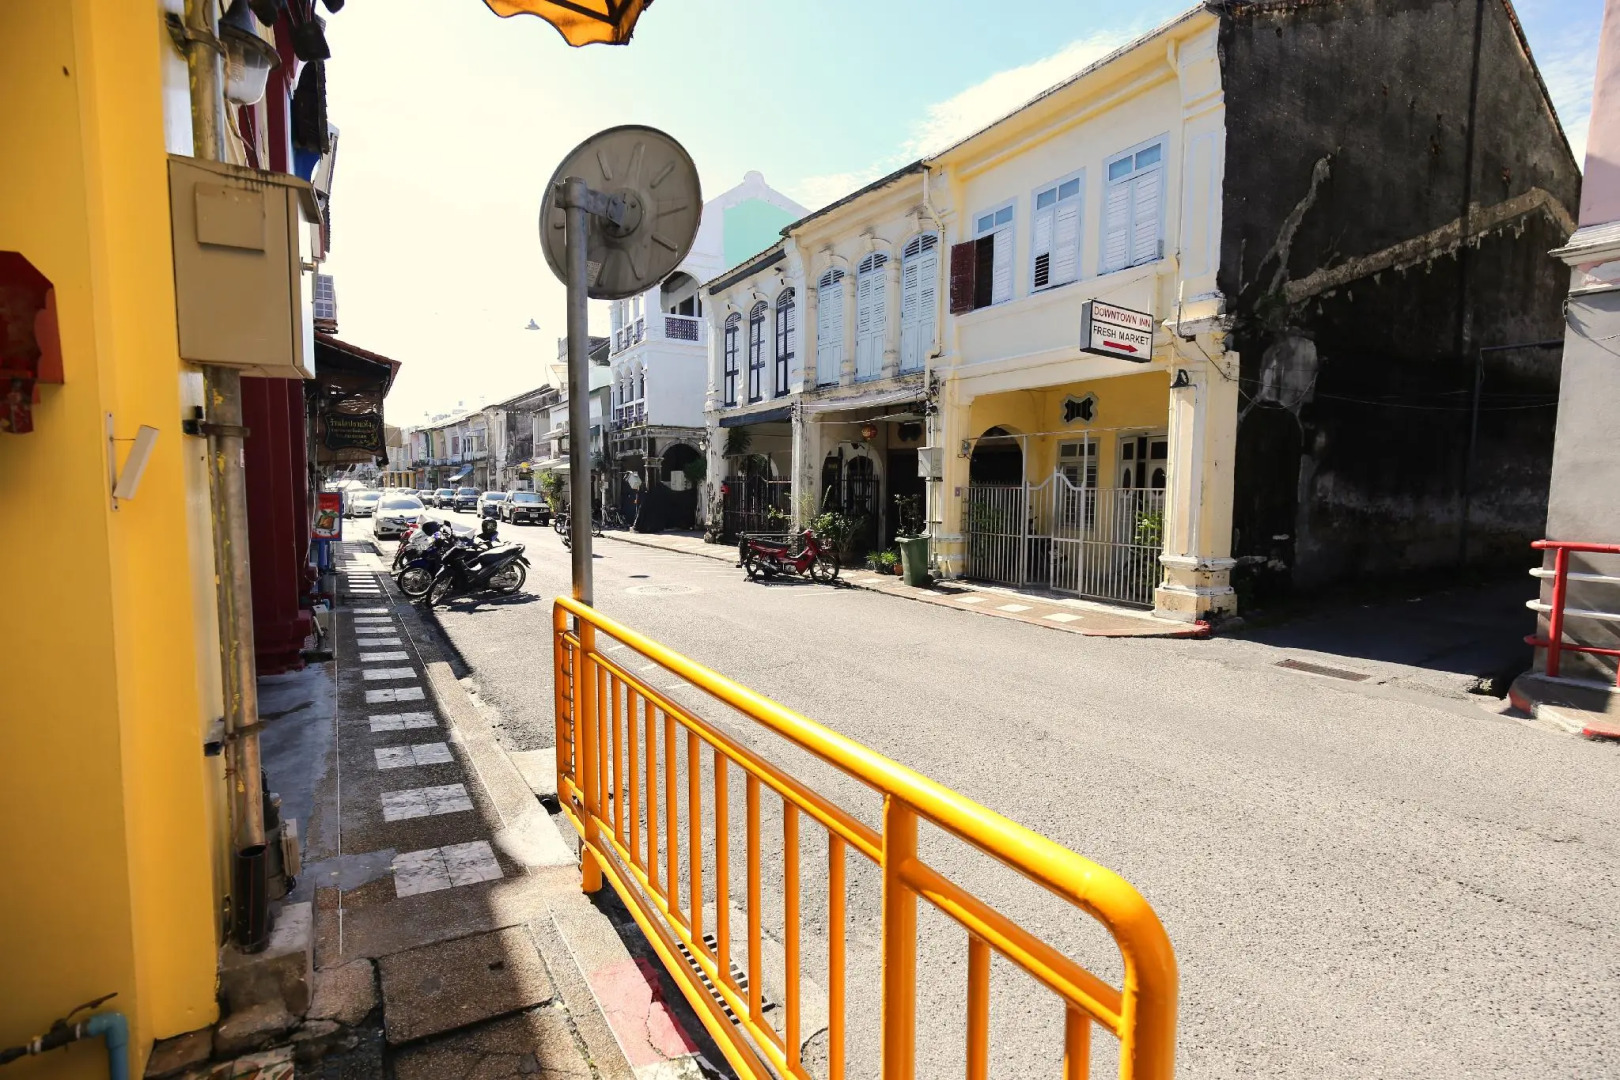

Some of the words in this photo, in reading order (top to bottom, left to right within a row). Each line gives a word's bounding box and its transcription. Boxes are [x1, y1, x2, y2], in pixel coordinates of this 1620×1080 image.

[1094, 306, 1137, 325] DOWNTOWN
[1139, 318, 1150, 328] INN
[1093, 325, 1116, 339] FRESH
[1118, 332, 1150, 346] MARKET
